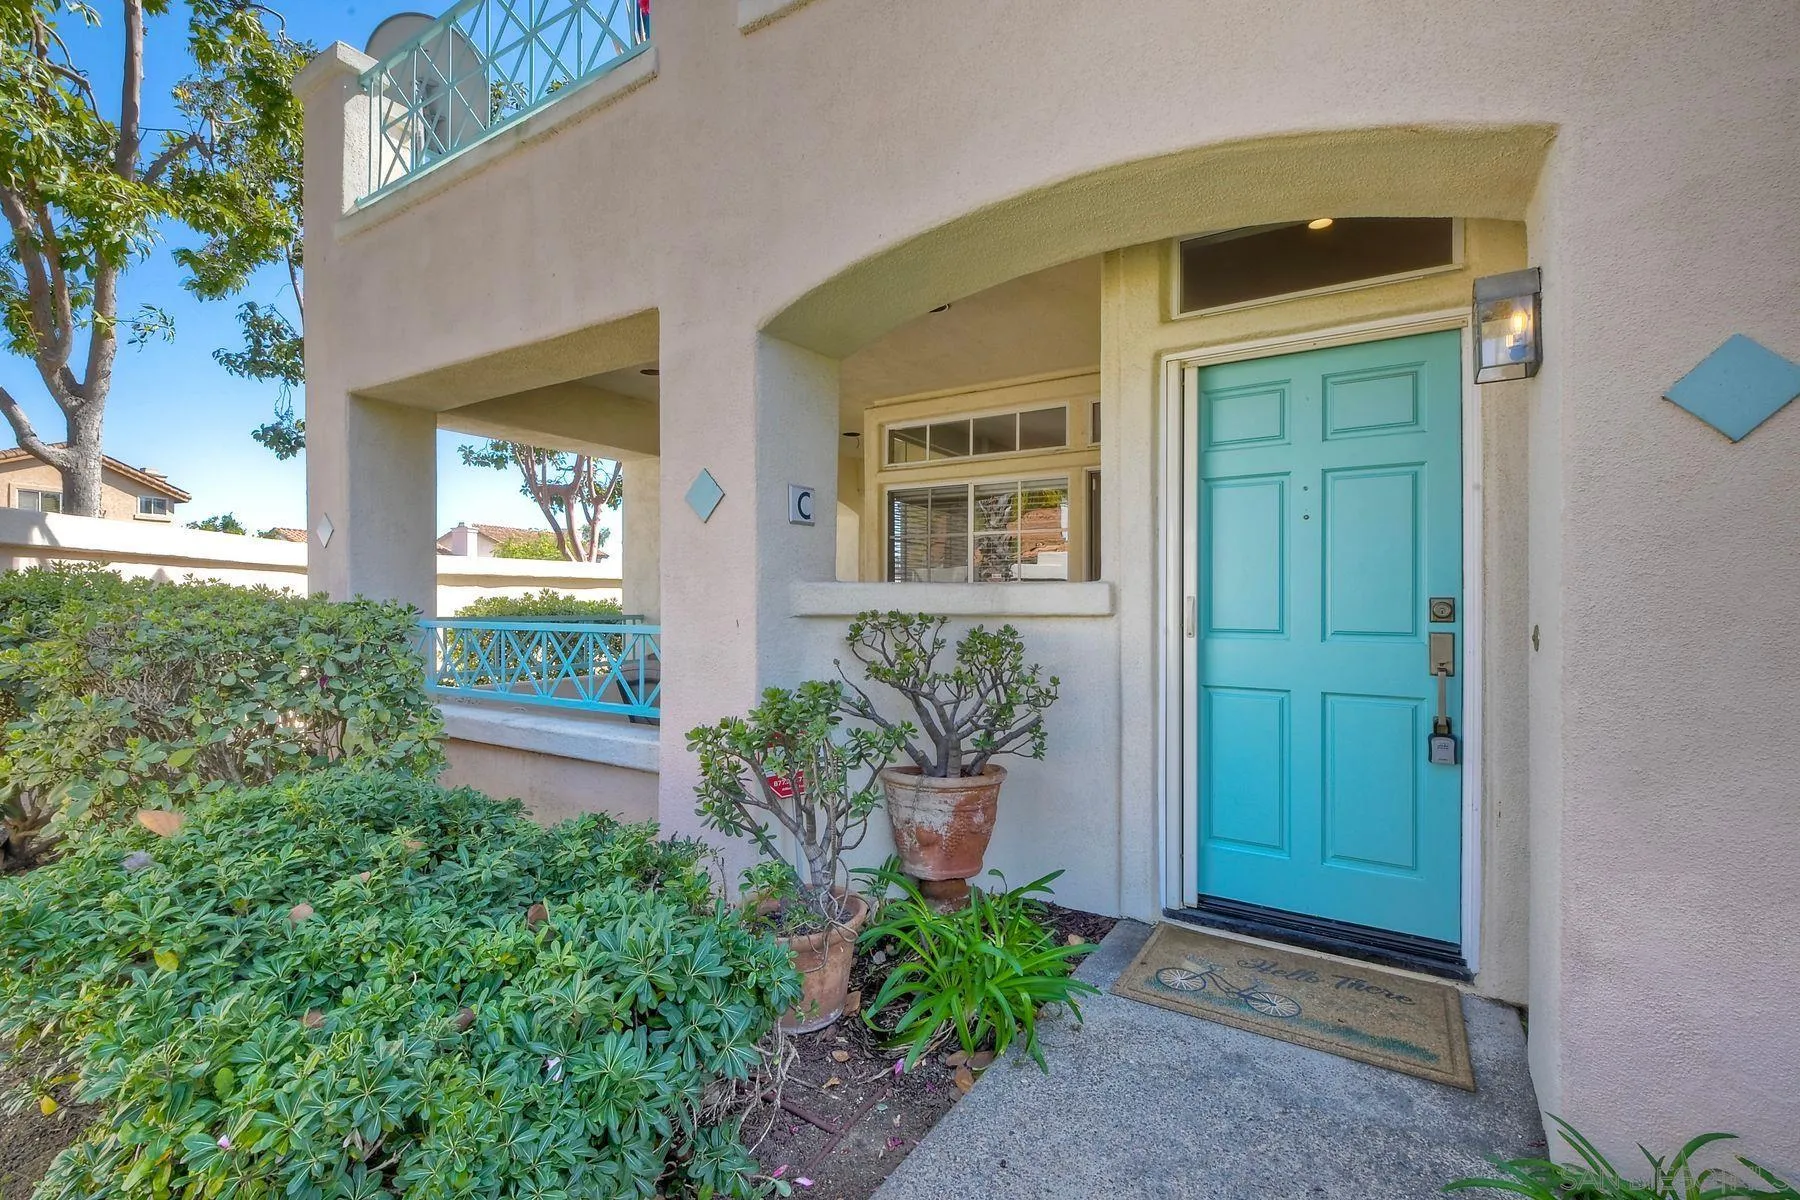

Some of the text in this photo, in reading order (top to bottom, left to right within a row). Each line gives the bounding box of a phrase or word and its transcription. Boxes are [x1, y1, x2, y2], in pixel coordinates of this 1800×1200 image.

[797, 491, 811, 520] C
[1237, 957, 1416, 1006] Hello There
